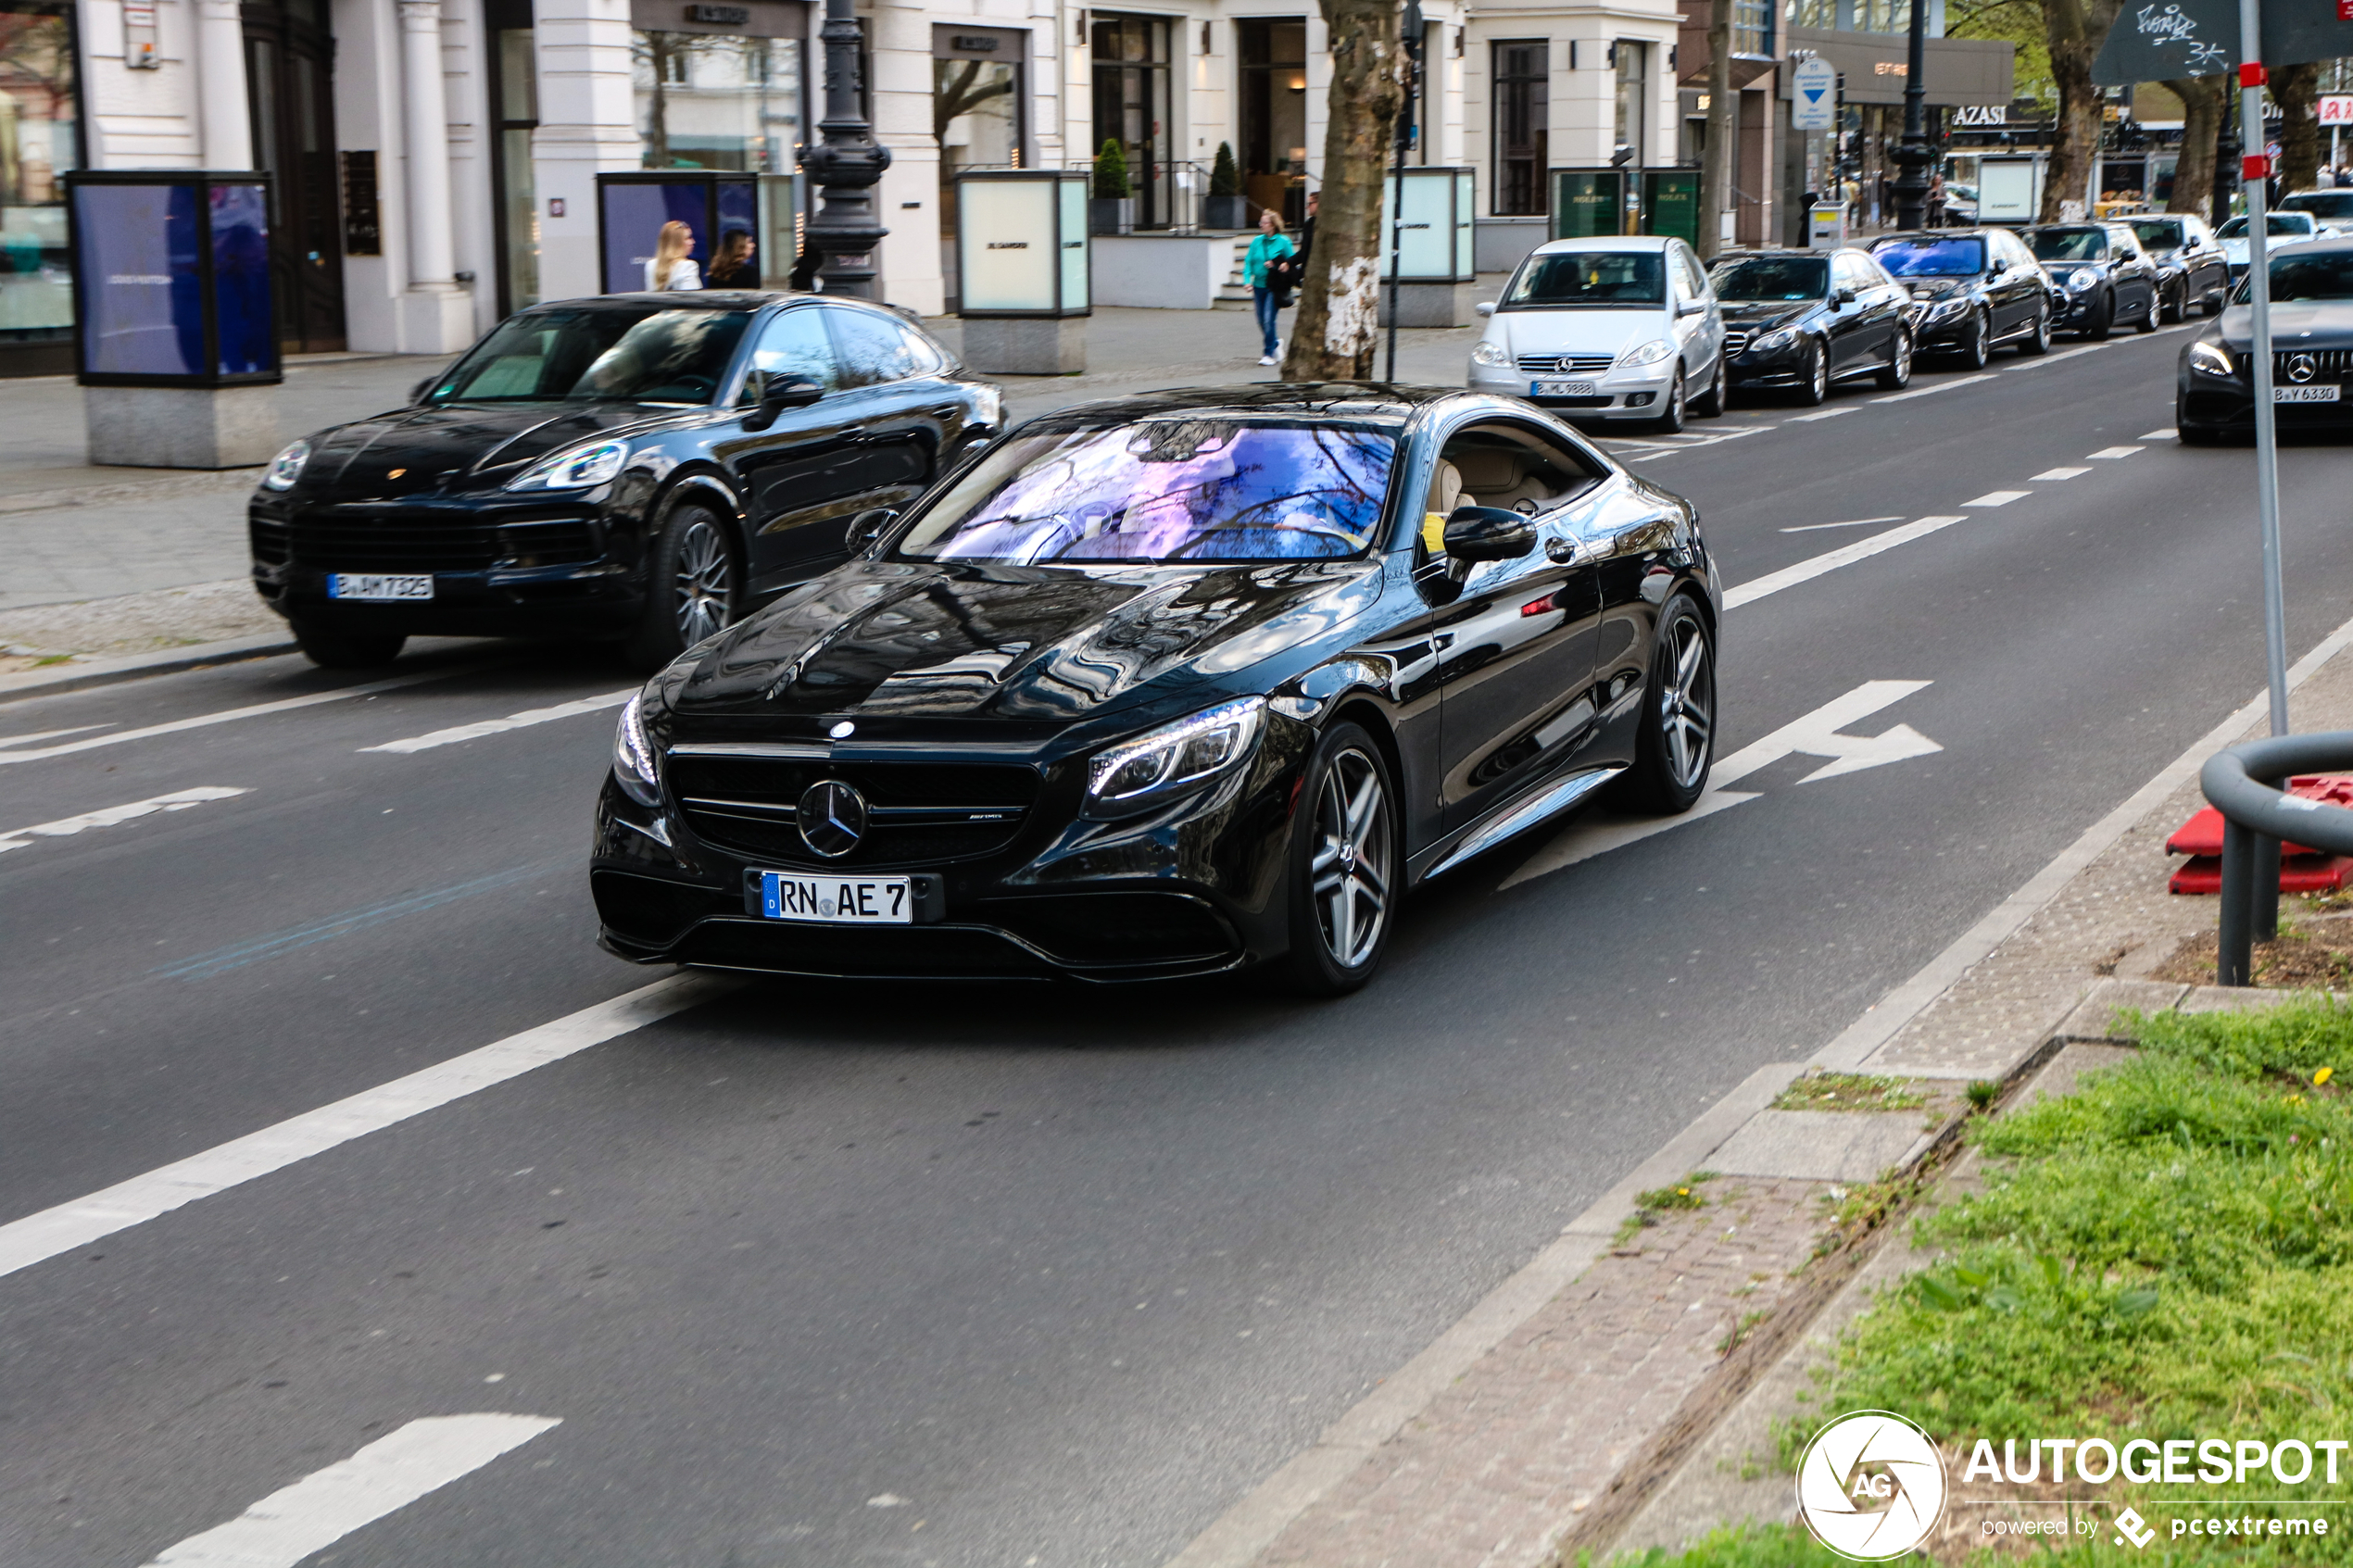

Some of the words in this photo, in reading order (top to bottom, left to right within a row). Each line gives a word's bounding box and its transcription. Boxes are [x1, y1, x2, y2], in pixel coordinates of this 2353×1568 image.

[2274, 389, 2283, 400] B
[2292, 388, 2299, 400] Y
[2302, 387, 2334, 400] 6330
[780, 880, 817, 914] RN
[837, 884, 879, 916] AE
[886, 884, 906, 916] 7
